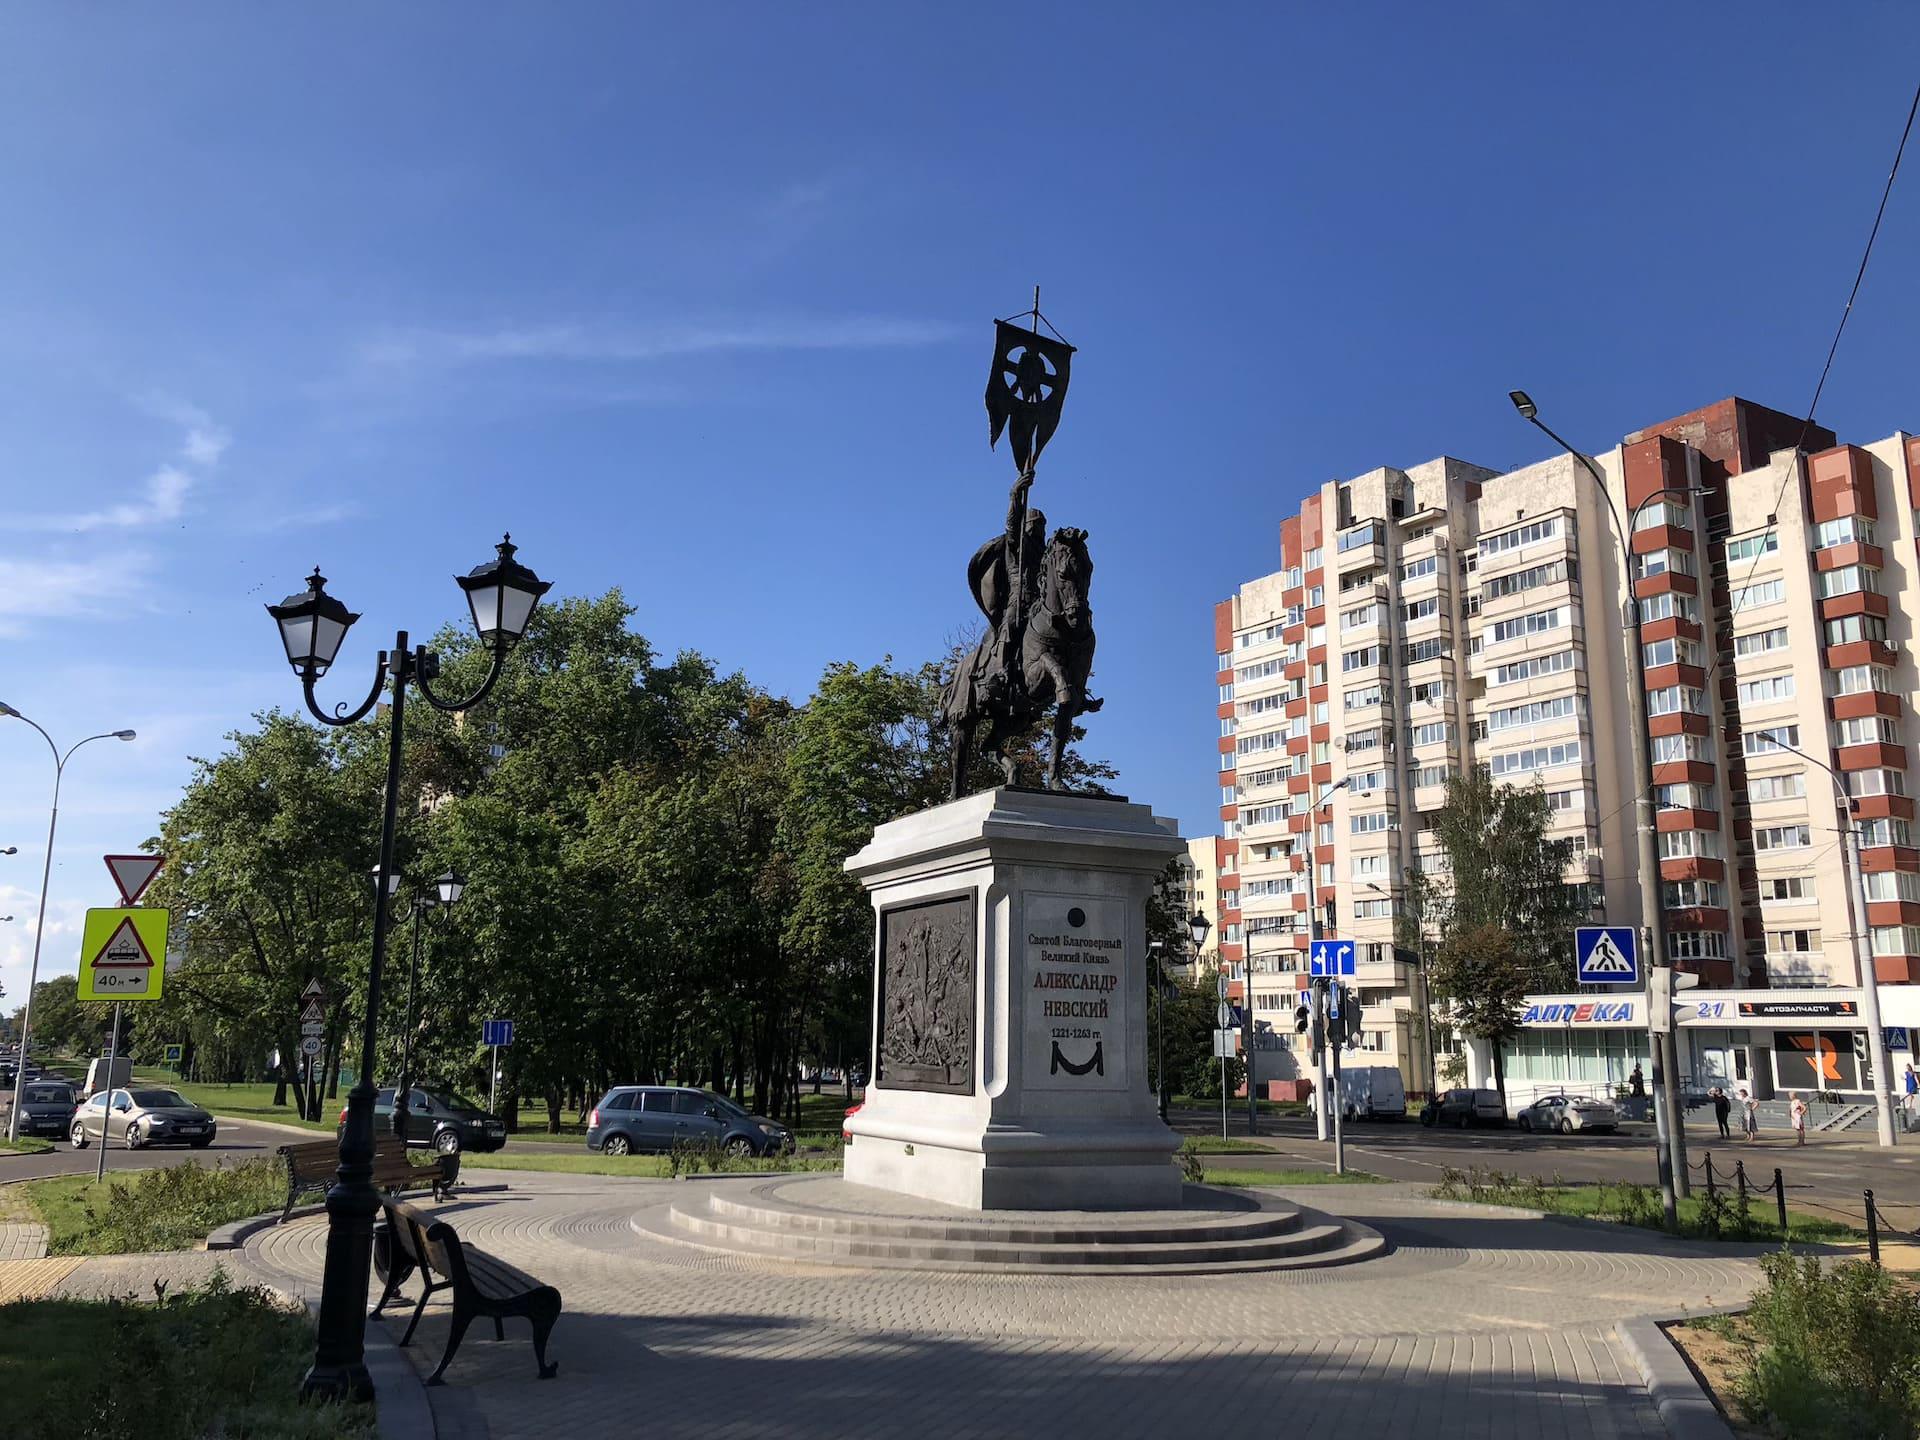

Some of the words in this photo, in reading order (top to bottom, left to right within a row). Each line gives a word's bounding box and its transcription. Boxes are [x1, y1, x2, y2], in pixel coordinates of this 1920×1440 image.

[1028, 933, 1060, 946] Святой
[1063, 935, 1122, 951] Благоверный
[1041, 950, 1080, 963] Великий
[1083, 952, 1110, 964] Князь
[1034, 972, 1117, 993] АЛЕКСАНДР
[1044, 998, 1108, 1018] НЕВСКИЙ
[1523, 1002, 1634, 1023] АПТЕКА
[1051, 1028, 1091, 1039] 1221-1263
[305, 1041, 318, 1050] 40
